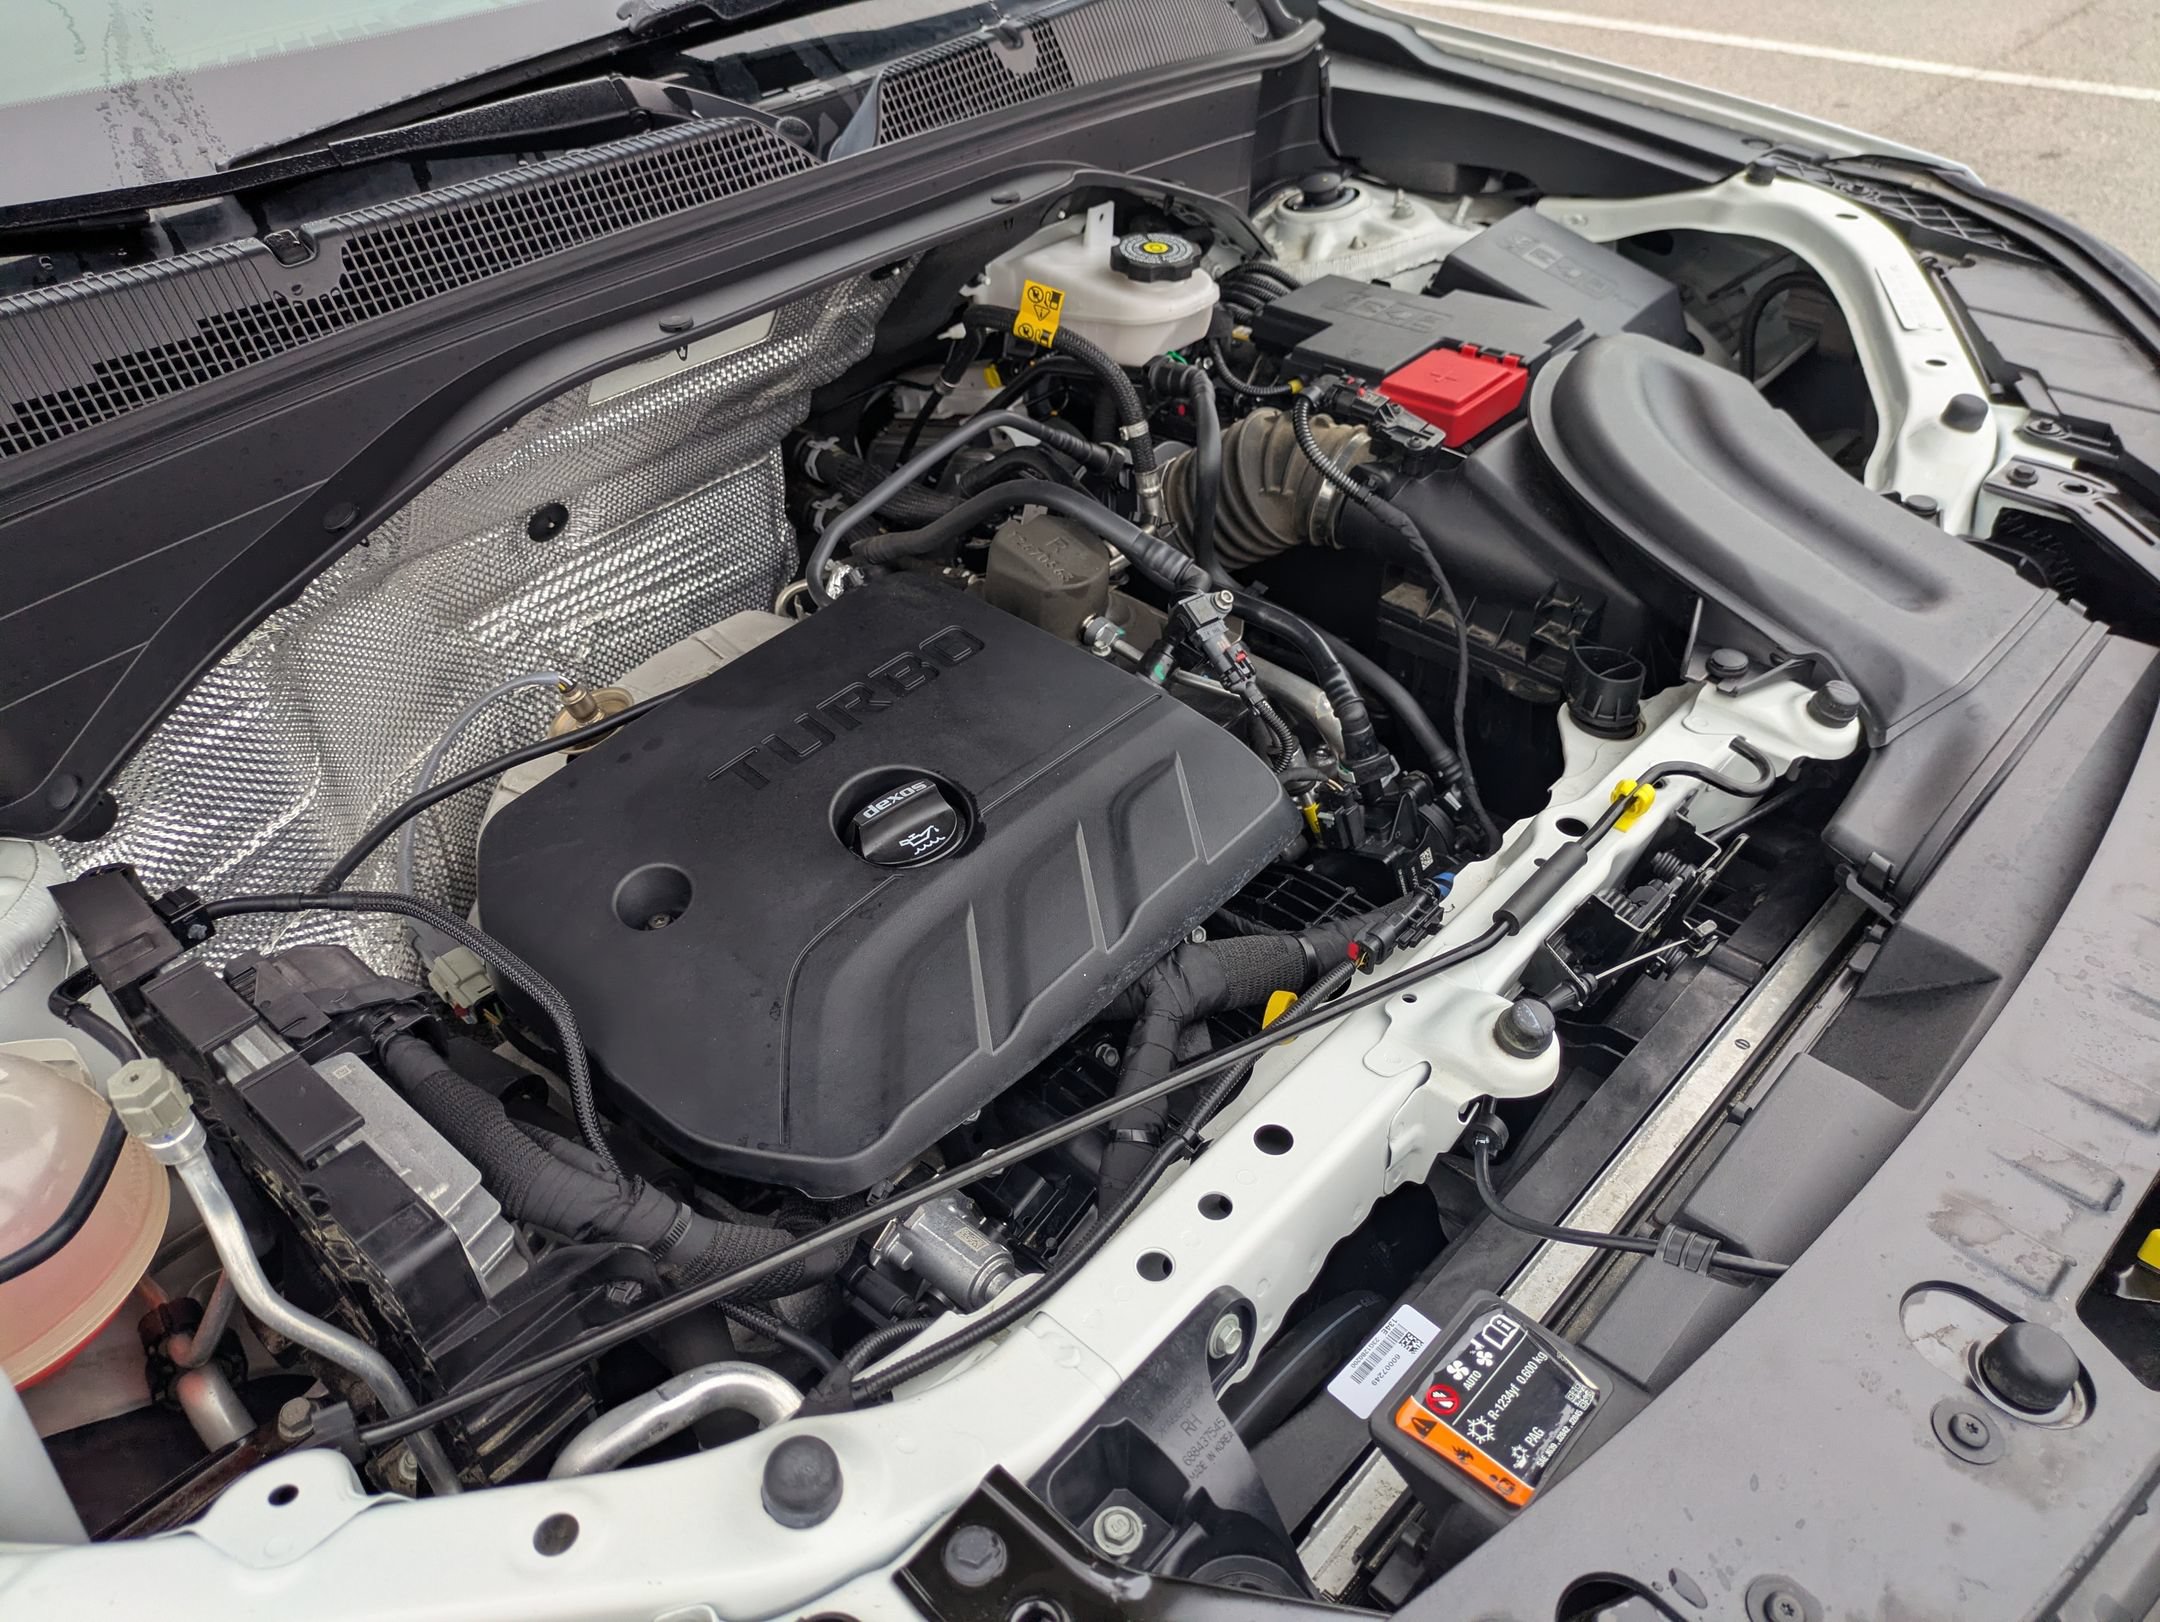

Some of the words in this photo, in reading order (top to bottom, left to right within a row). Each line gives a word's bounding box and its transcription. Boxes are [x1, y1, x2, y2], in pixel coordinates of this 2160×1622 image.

[706, 624, 985, 790] TURBO
[863, 781, 928, 819] dexos
[1463, 1369, 1482, 1392] AUTO
[1487, 1383, 1520, 1421] R-1234yf
[1516, 1361, 1538, 1385] 0.600
[1532, 1351, 1548, 1365] kg
[1180, 1412, 1203, 1437] RH
[1524, 1426, 1545, 1447] PAG
[1189, 1460, 1208, 1479] MADE
[1207, 1451, 1216, 1461] IN
[1215, 1430, 1234, 1453] KOREA
[1536, 1455, 1549, 1468] SAE
